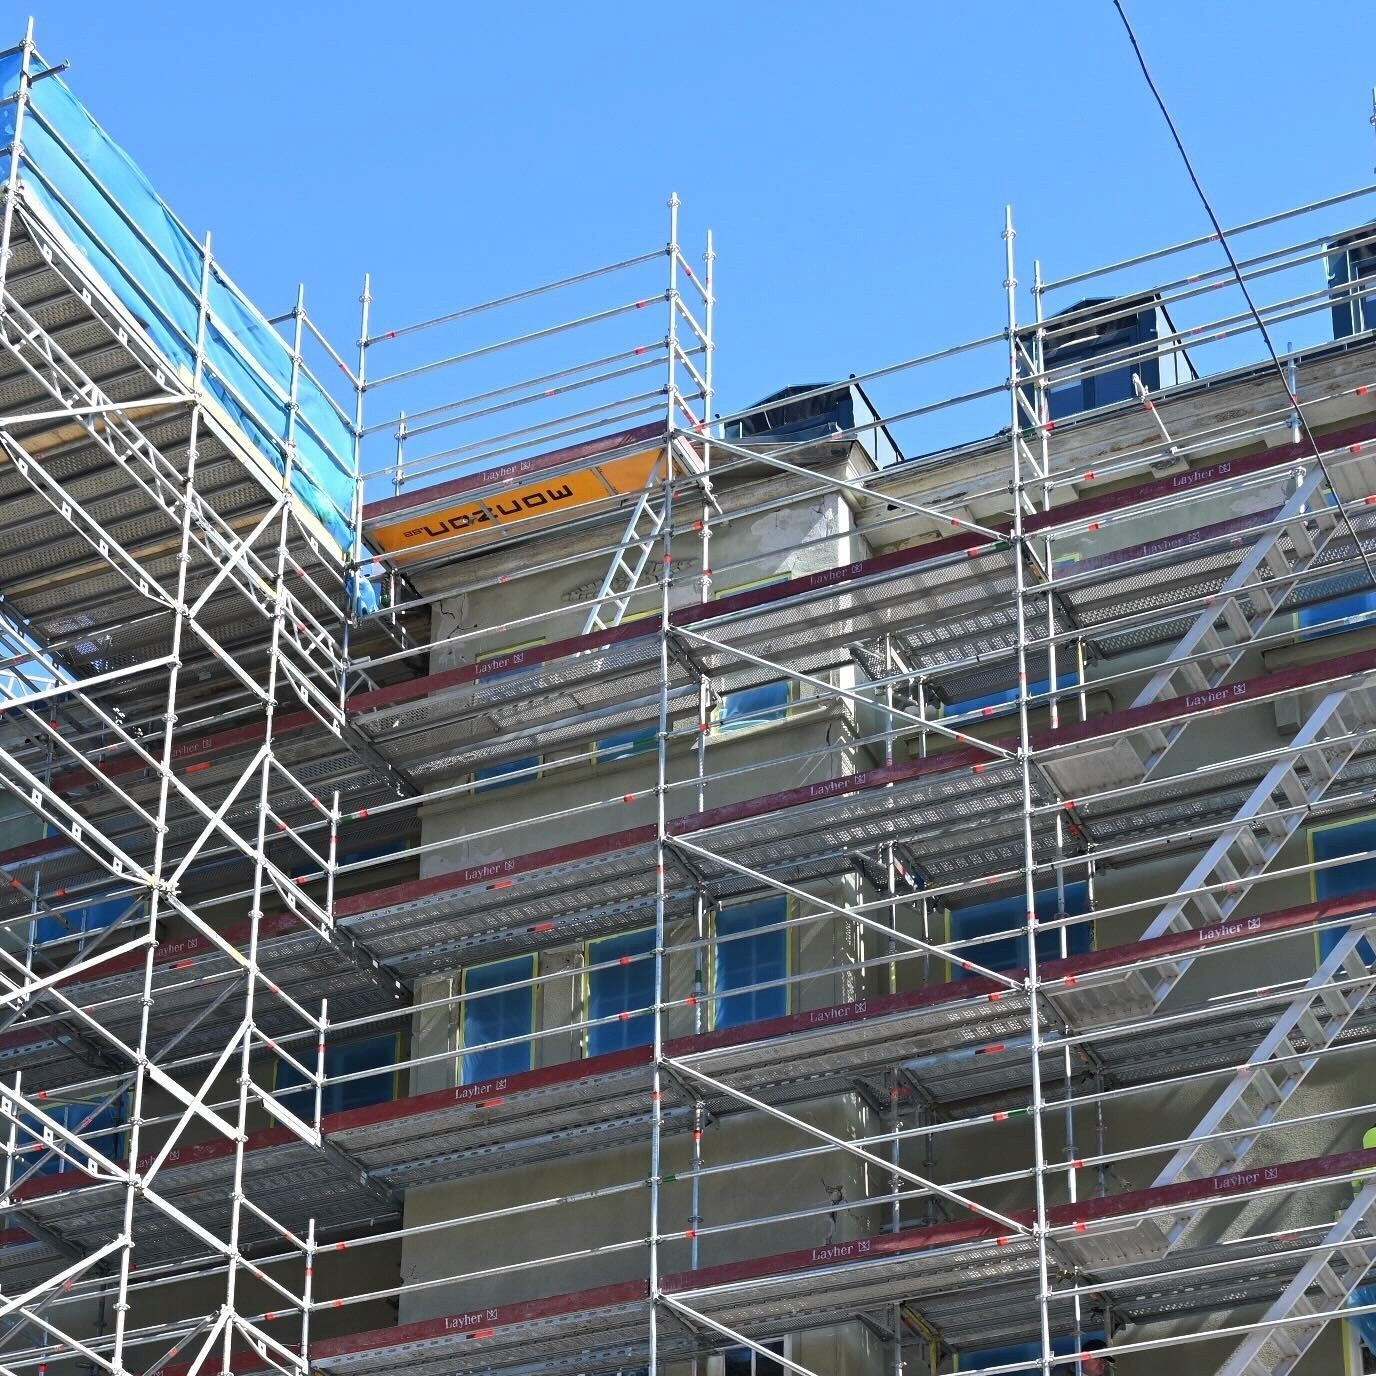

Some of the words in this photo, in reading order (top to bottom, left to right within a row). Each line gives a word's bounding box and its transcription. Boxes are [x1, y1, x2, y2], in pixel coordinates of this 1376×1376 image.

[483, 465, 517, 482] Layher
[1173, 469, 1214, 487] Layher
[475, 658, 510, 675] Layher
[1186, 690, 1229, 708] Layher
[810, 779, 850, 797] Layher
[465, 863, 501, 881] Layher
[1199, 924, 1242, 941] Layher
[810, 1007, 851, 1022] Layher
[455, 1084, 492, 1099] Layher
[1214, 1172, 1260, 1190] Layher
[812, 1245, 853, 1261] Layher
[445, 1313, 483, 1329] Layher
